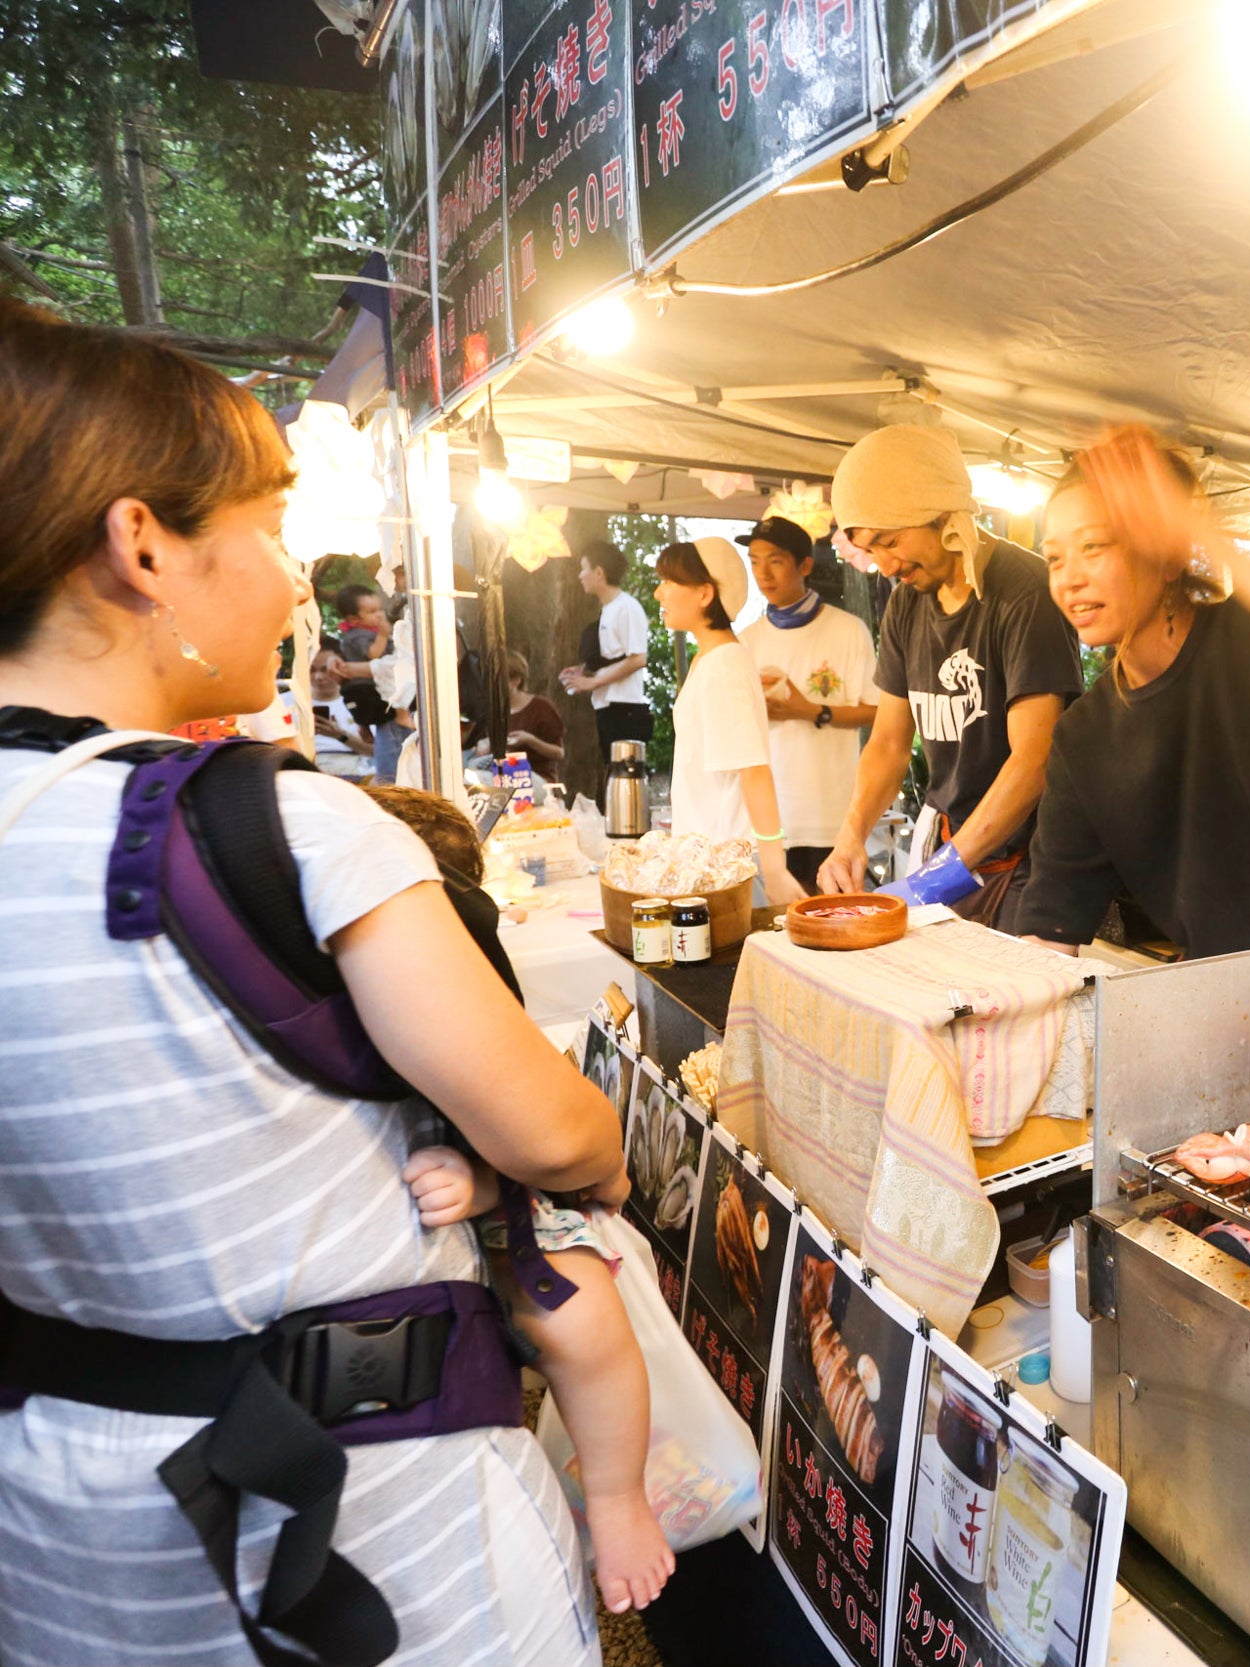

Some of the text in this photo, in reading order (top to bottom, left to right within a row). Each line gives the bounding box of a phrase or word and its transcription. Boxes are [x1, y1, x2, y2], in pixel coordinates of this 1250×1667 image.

[511, 0, 613, 167] げそ焼き
[538, 130, 572, 183] Squid
[574, 88, 623, 150] (Legs)
[640, 89, 685, 188] 1杯
[551, 154, 625, 260] 350円
[786, 1422, 874, 1570] いか焼き
[941, 1490, 961, 1526] Wine
[1003, 1553, 1028, 1591] Wine
[1004, 1535, 1031, 1575] White
[816, 1553, 878, 1658] 550円
[905, 1581, 984, 1667] カップワ
